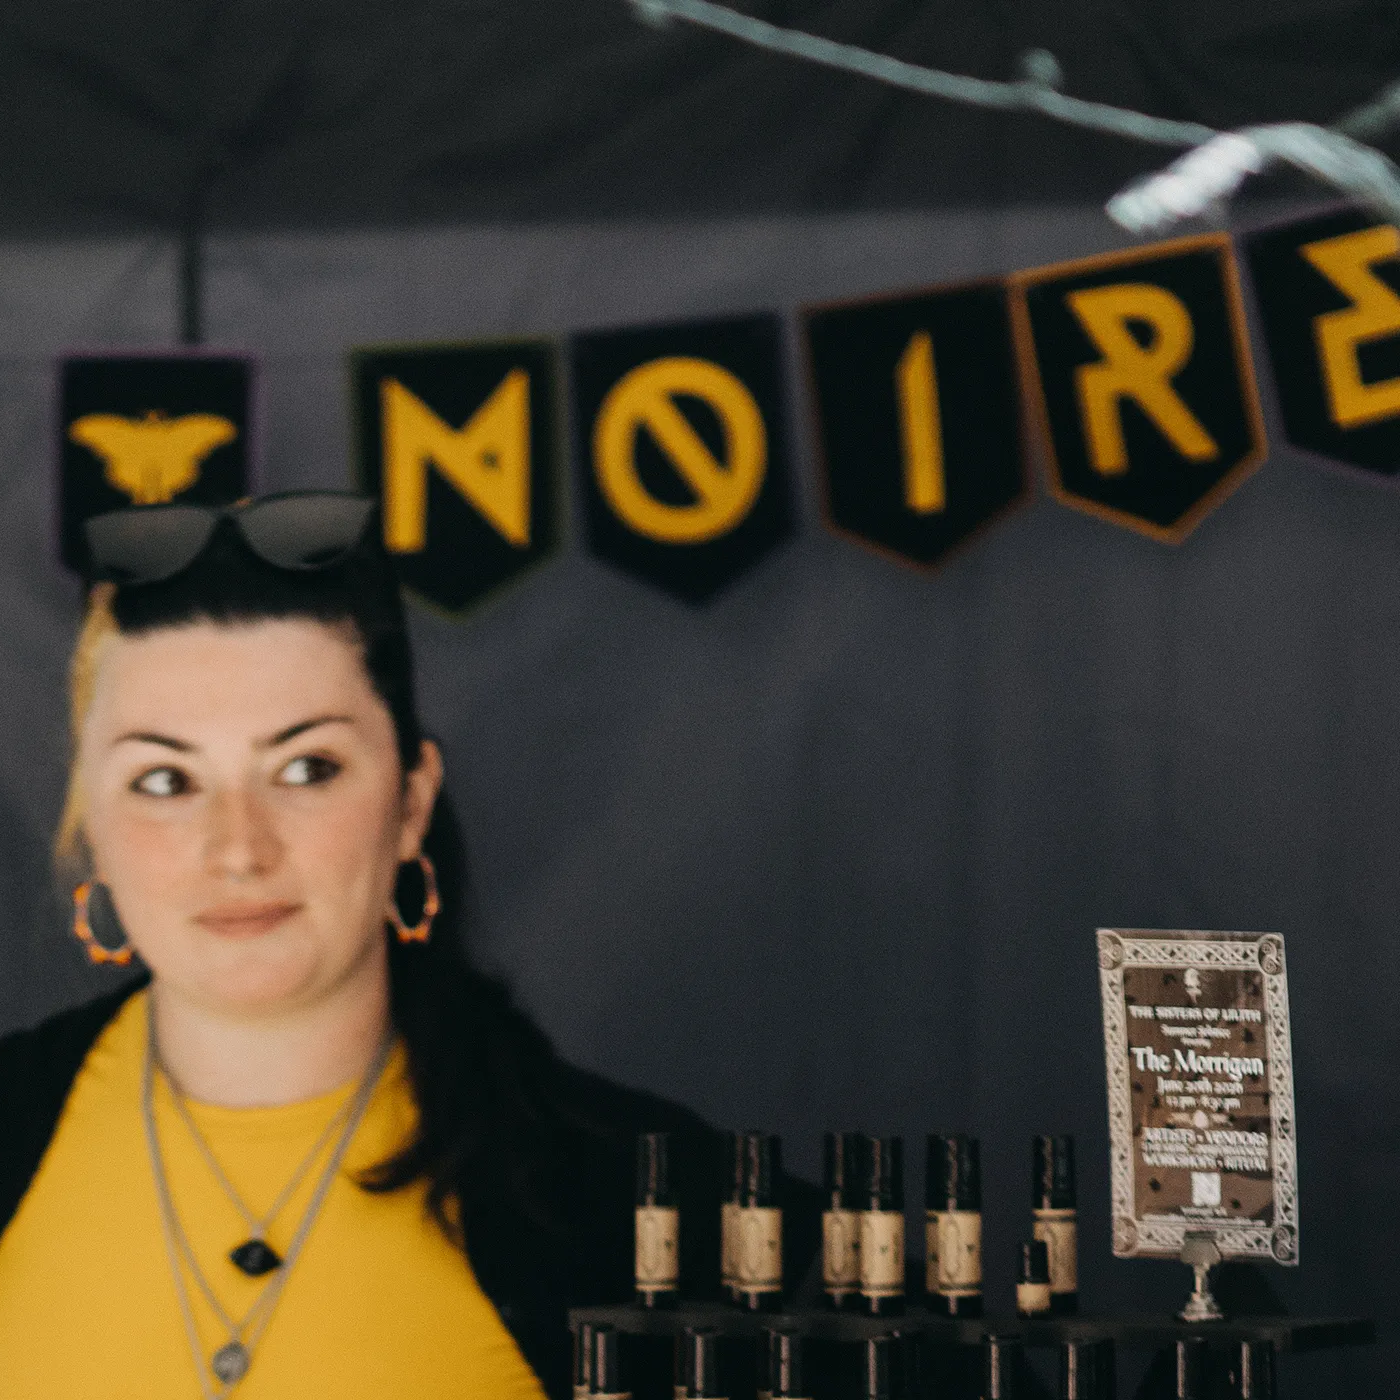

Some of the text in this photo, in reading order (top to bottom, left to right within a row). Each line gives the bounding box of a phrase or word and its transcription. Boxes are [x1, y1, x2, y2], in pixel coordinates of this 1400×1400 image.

[1203, 1007, 1220, 1021] OF
[1130, 1046, 1265, 1082] The Morrigan
